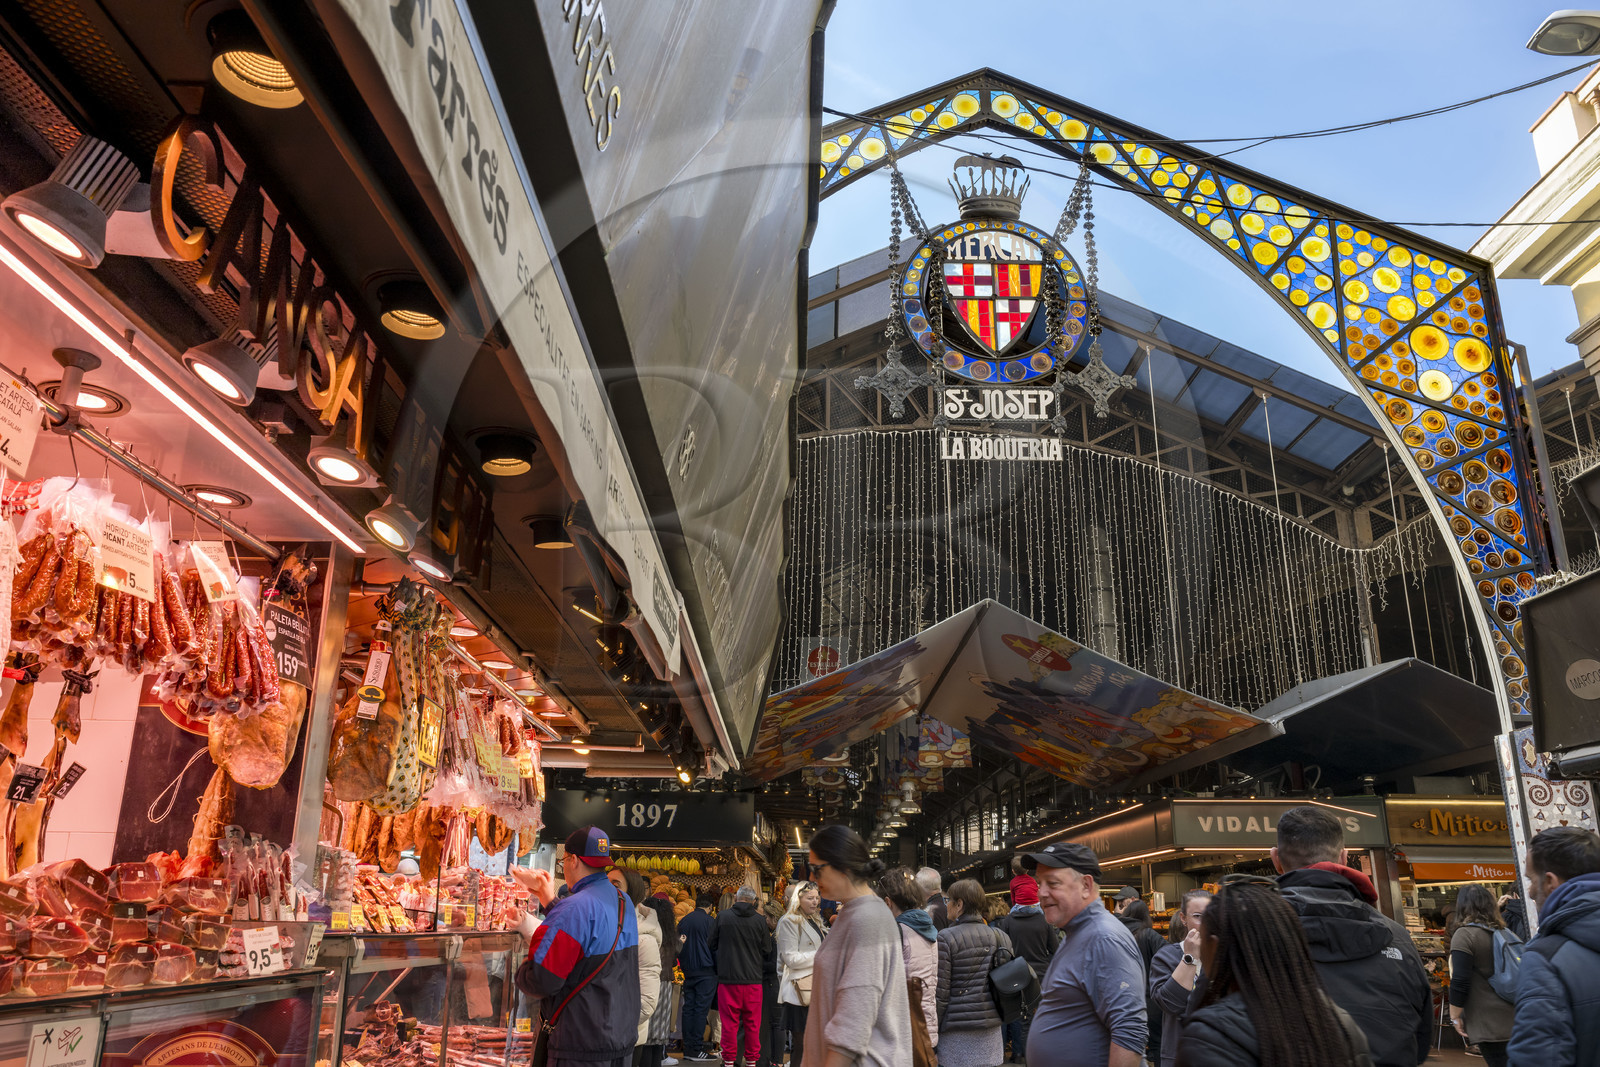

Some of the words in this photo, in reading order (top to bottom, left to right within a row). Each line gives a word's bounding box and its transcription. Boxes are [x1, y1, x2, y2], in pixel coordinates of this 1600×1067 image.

[946, 231, 1042, 260] MERCAT
[970, 389, 1054, 419] JOSEP
[941, 437, 965, 460] LA
[969, 437, 1063, 460] BOQUERIA
[103, 531, 125, 546] PICANT
[129, 572, 136, 588] 5
[270, 610, 292, 627] PALETA
[277, 651, 298, 678] 159
[1570, 669, 1600, 689] MARCO
[12, 785, 26, 800] 21
[616, 803, 678, 828] 1897
[1198, 816, 1277, 833] VIDAL
[1428, 808, 1498, 836] Mitic
[1473, 864, 1504, 878] Mitic
[249, 948, 271, 971] 9,5
[157, 1042, 195, 1064] ARTESANS
[208, 1042, 247, 1064] L'EMBOTIT
